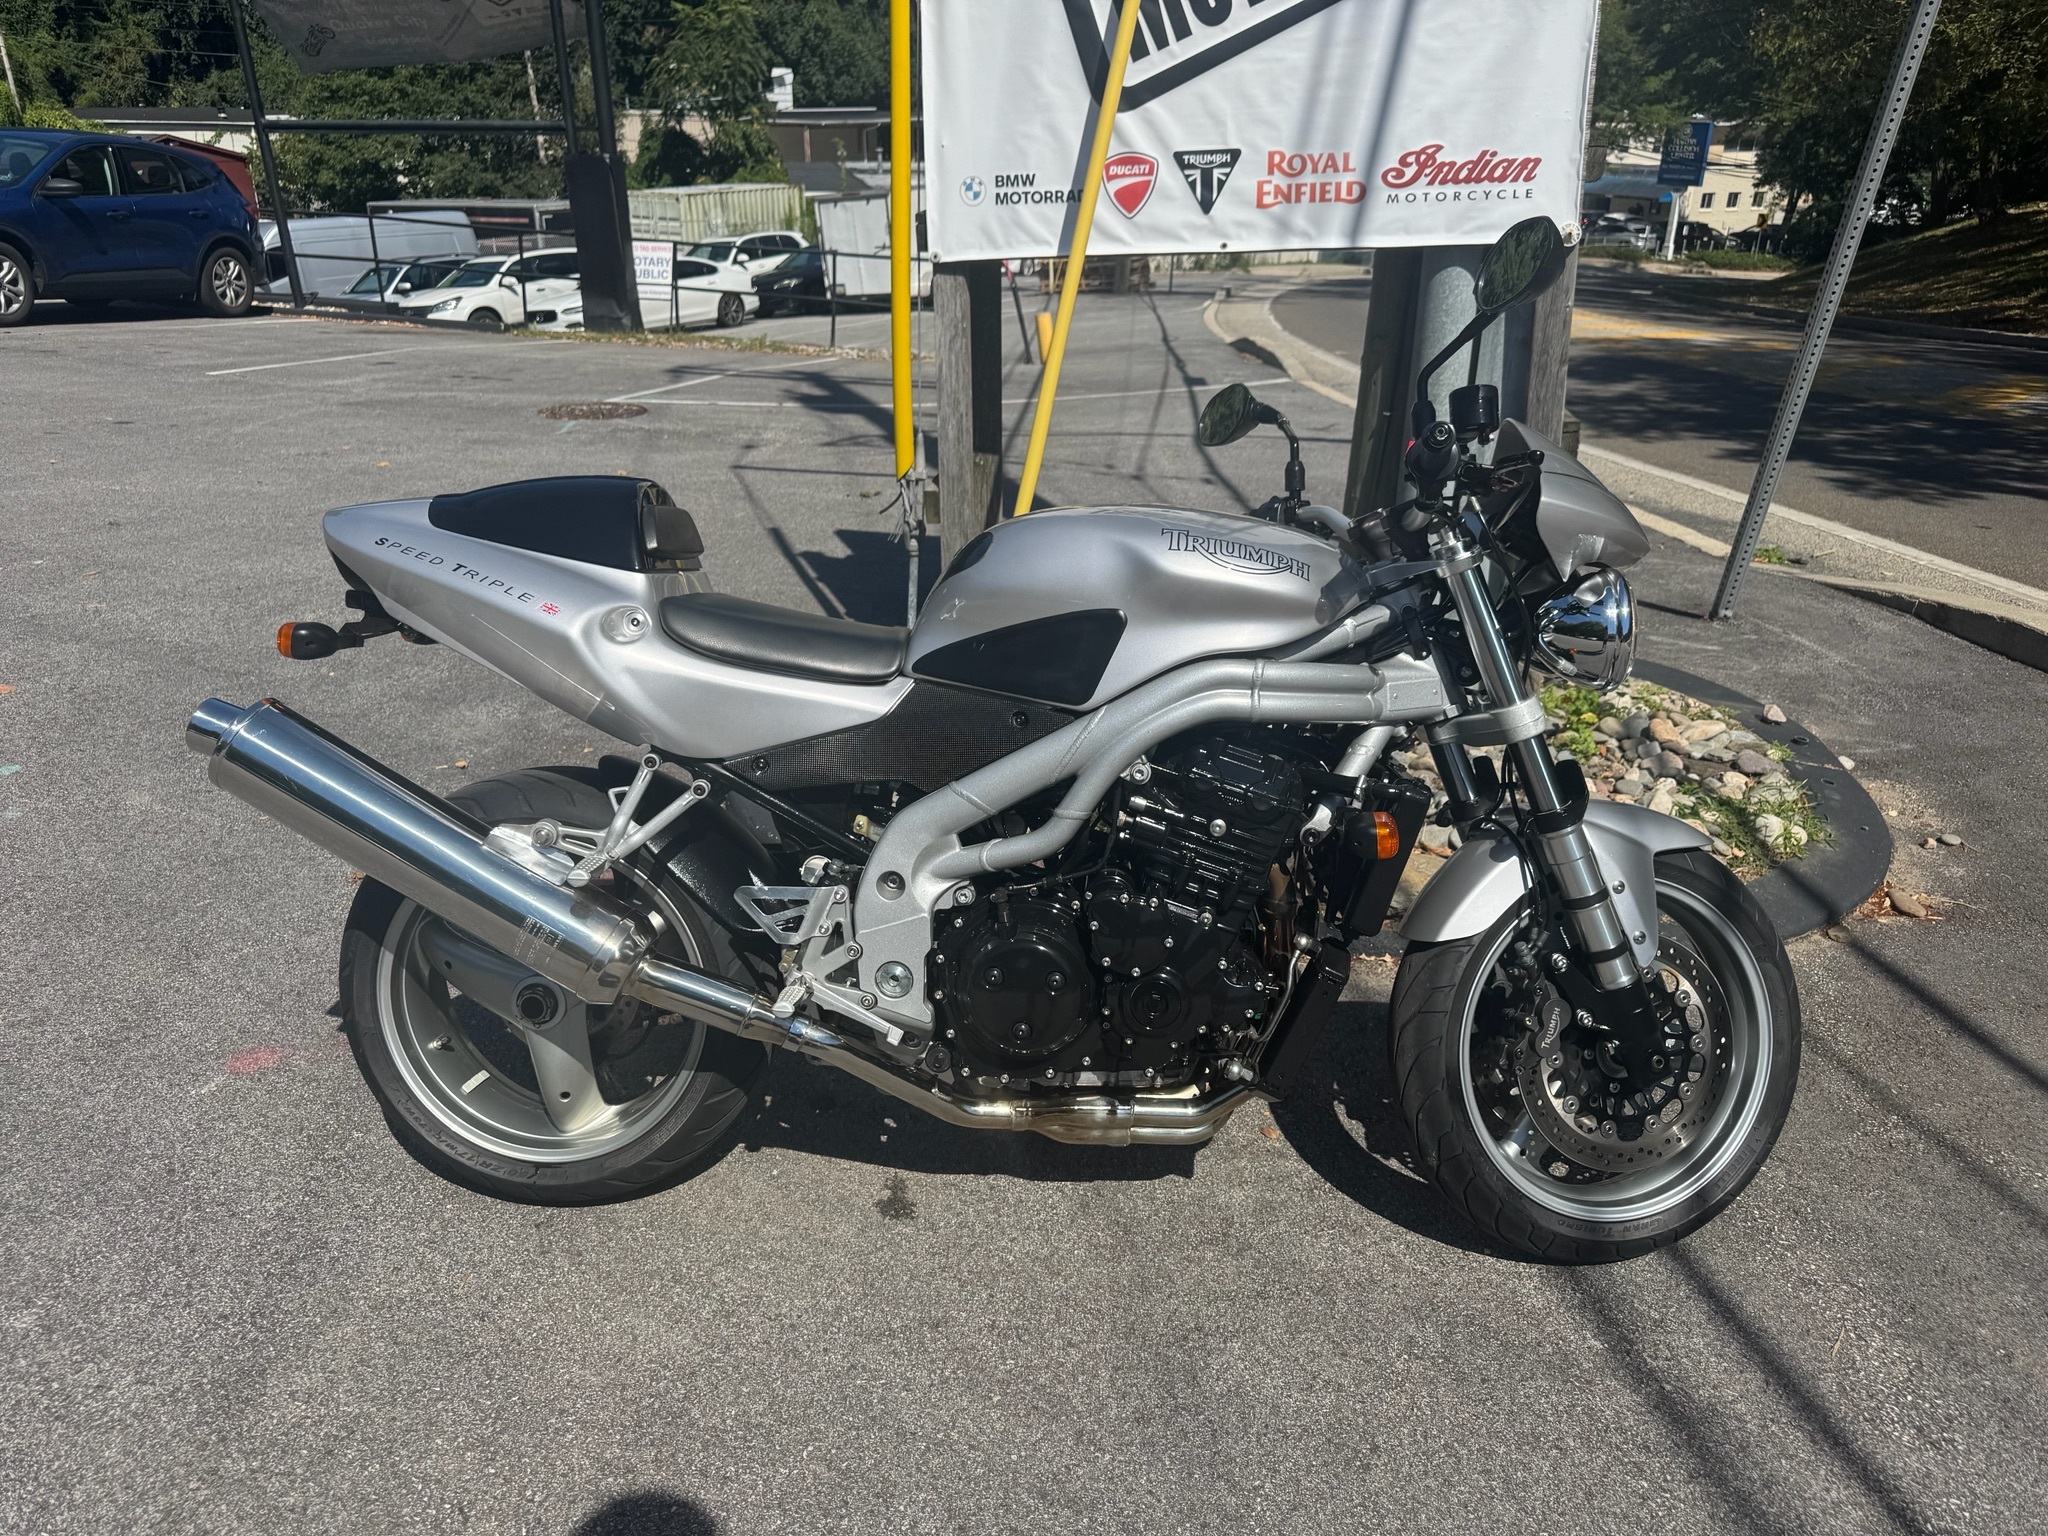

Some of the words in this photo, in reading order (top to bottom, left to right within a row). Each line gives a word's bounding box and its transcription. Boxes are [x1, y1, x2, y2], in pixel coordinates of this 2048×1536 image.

[1182, 152, 1231, 168] TRIUMPH
[1266, 150, 1356, 178] ROYAL
[1380, 143, 1543, 190] Indian
[1108, 163, 1150, 176] DUCATI
[995, 173, 1036, 188] BMW
[1255, 179, 1367, 209] ENFIELD
[1385, 188, 1534, 205] MOTORCYCLE
[634, 256, 671, 268] OTARY
[637, 268, 669, 280] UBLIC
[1161, 528, 1311, 582] TRIUMPH
[374, 537, 444, 566] SPEED
[451, 563, 535, 603] TRIPLE
[1541, 1007, 1561, 1049] TRIUMPH
[1557, 1219, 1615, 1238] TURISMO
[1623, 1216, 1663, 1233] GRAN
